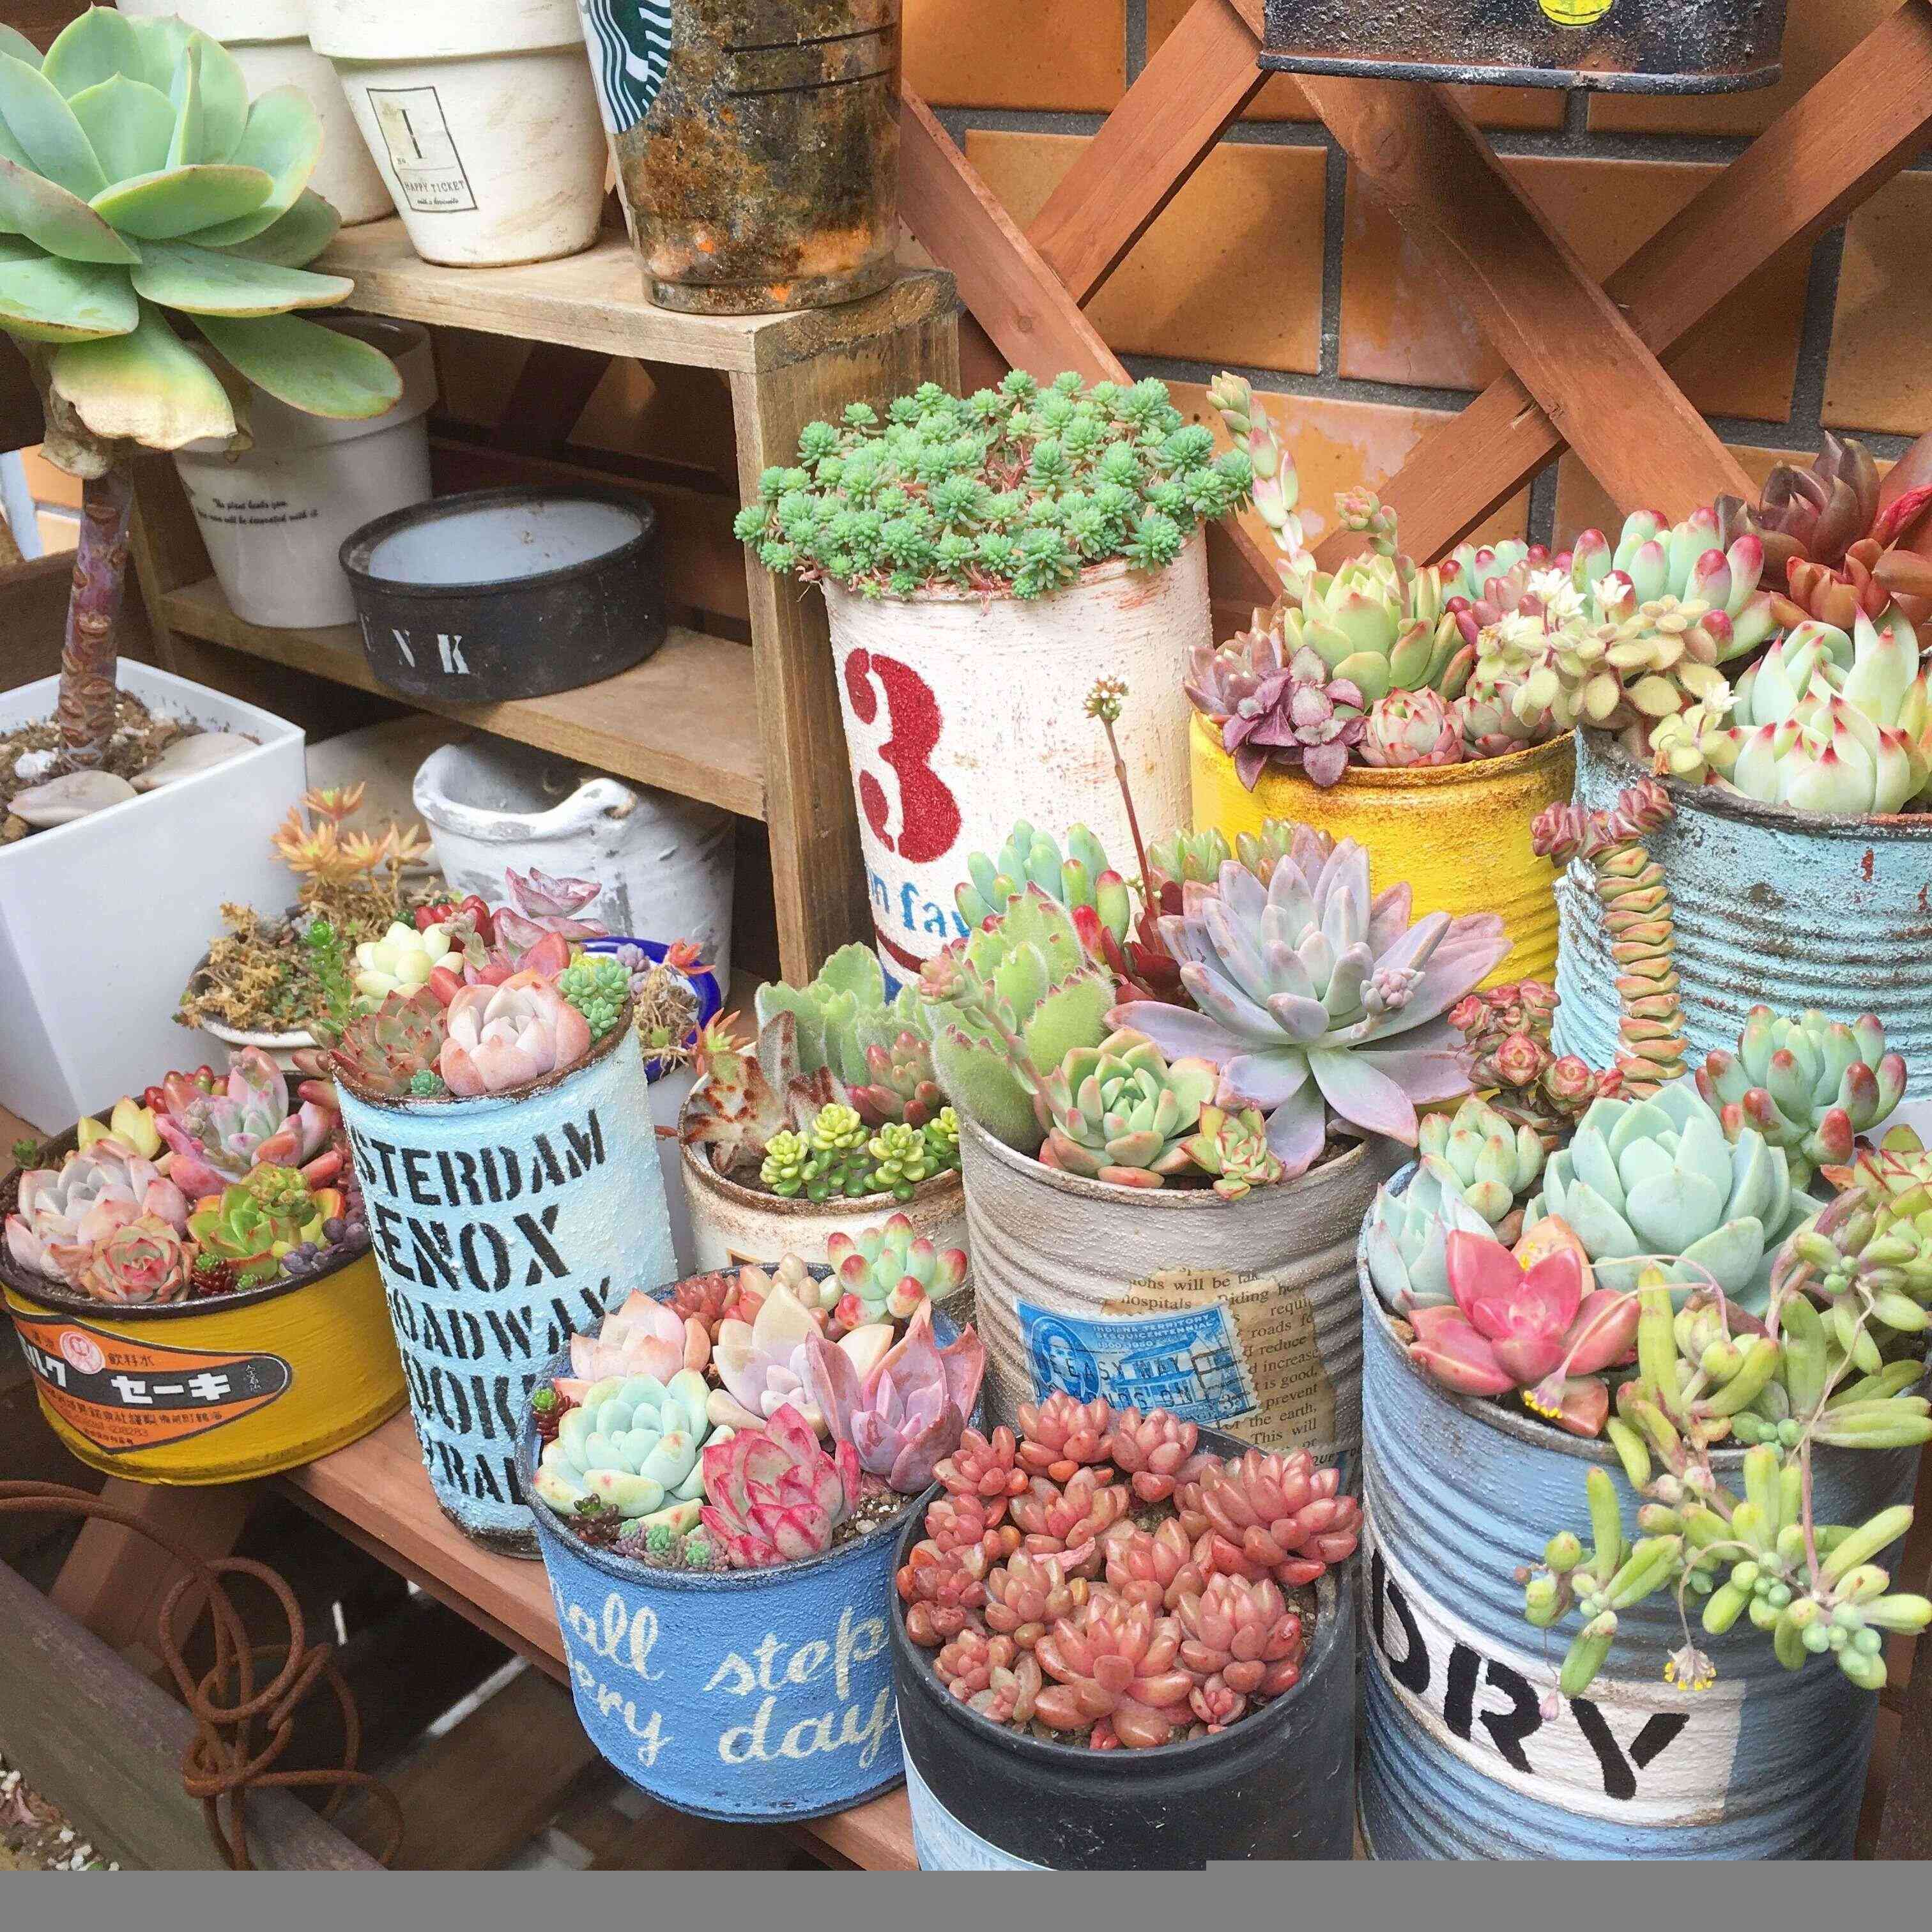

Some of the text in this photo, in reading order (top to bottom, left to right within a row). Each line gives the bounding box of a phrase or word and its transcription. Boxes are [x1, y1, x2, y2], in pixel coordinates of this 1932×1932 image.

[405, 180, 464, 192] HAPPY TICKET
[845, 648, 962, 862] 3
[374, 1201, 570, 1293] ENOX
[1174, 1277, 1205, 1291] will
[1213, 1276, 1230, 1288] be
[1121, 1293, 1192, 1310] hospitals
[390, 1276, 610, 1361] OADWAY
[1093, 1314, 1209, 1333] INDIANA TERRITORY
[1251, 1319, 1292, 1338] roads
[1259, 1335, 1308, 1356] reduce
[110, 1372, 231, 1402] セーキ
[1263, 1382, 1318, 1412] prevent
[1264, 1380, 1276, 1391] is
[1250, 1413, 1271, 1427] the
[1250, 1417, 1317, 1446] This will
[565, 1593, 887, 1701] all step
[717, 1686, 895, 1770] day
